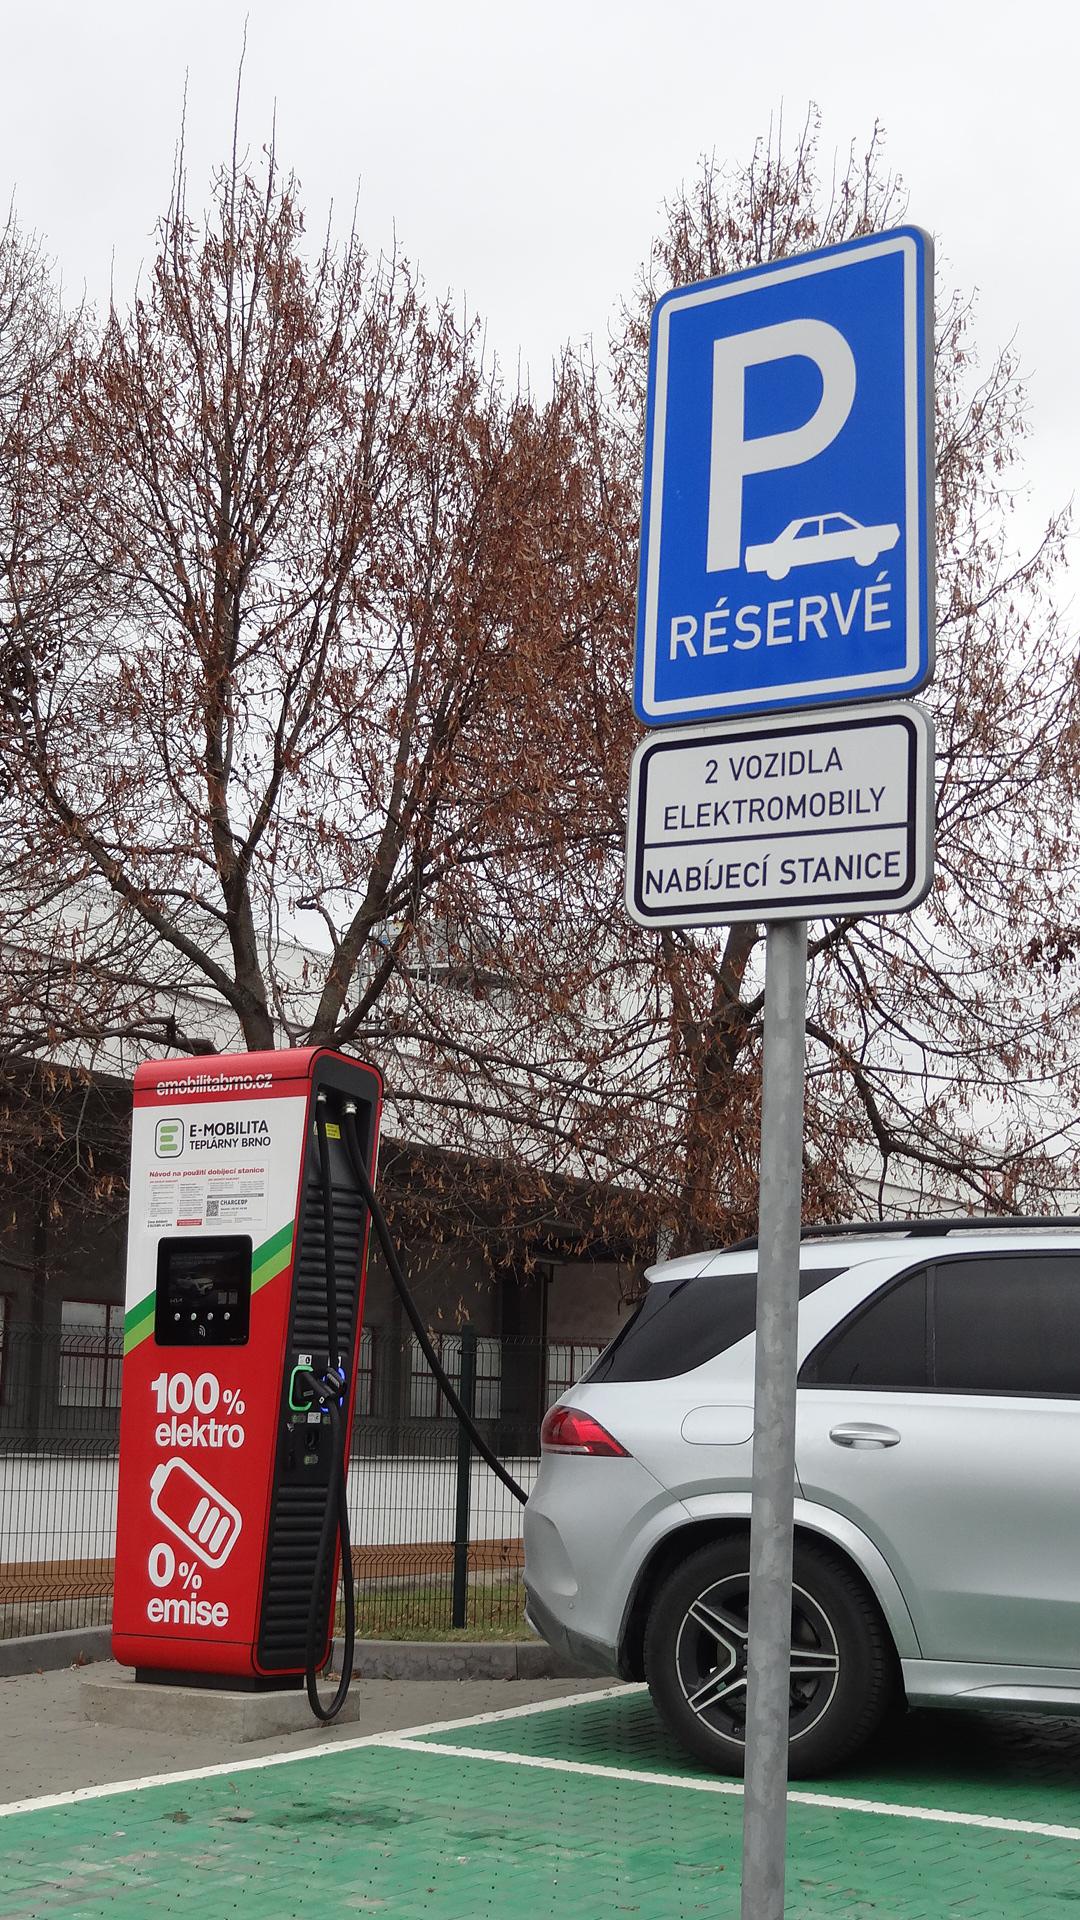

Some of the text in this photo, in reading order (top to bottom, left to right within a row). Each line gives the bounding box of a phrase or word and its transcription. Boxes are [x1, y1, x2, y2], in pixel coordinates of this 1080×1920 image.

[706, 318, 857, 573] P
[669, 571, 892, 660] RÉSERVÉ
[704, 747, 843, 784] 2 VOZIDLA
[663, 786, 886, 831] ELEKTROMOBILY
[645, 851, 901, 895] NABÍJECÍ STANICE
[156, 1073, 273, 1096] emobilitabrno.cz
[189, 1120, 269, 1137] E-MOBILITA
[189, 1137, 271, 1150] TEPLÁRNY BRNO
[149, 1170, 171, 1178] Návod
[155, 1416, 245, 1448] elektro
[147, 1592, 229, 1627] emise
